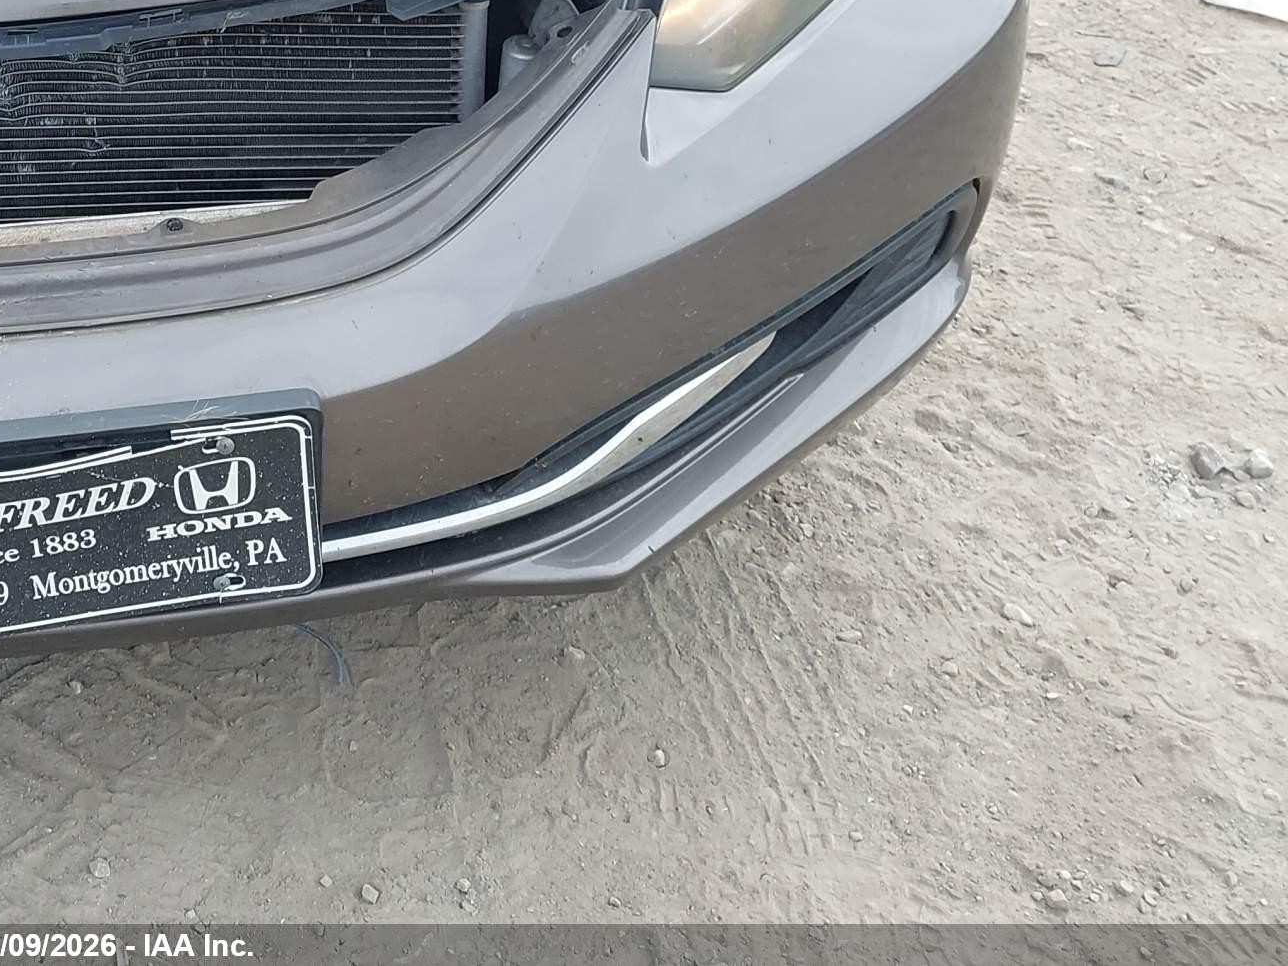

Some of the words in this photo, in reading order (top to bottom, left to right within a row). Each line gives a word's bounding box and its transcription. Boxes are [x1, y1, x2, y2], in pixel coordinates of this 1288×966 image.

[145, 506, 293, 542] HONDA
[30, 528, 98, 559] 1883
[31, 544, 240, 601] Montgomeryville,
[247, 535, 288, 567] PA
